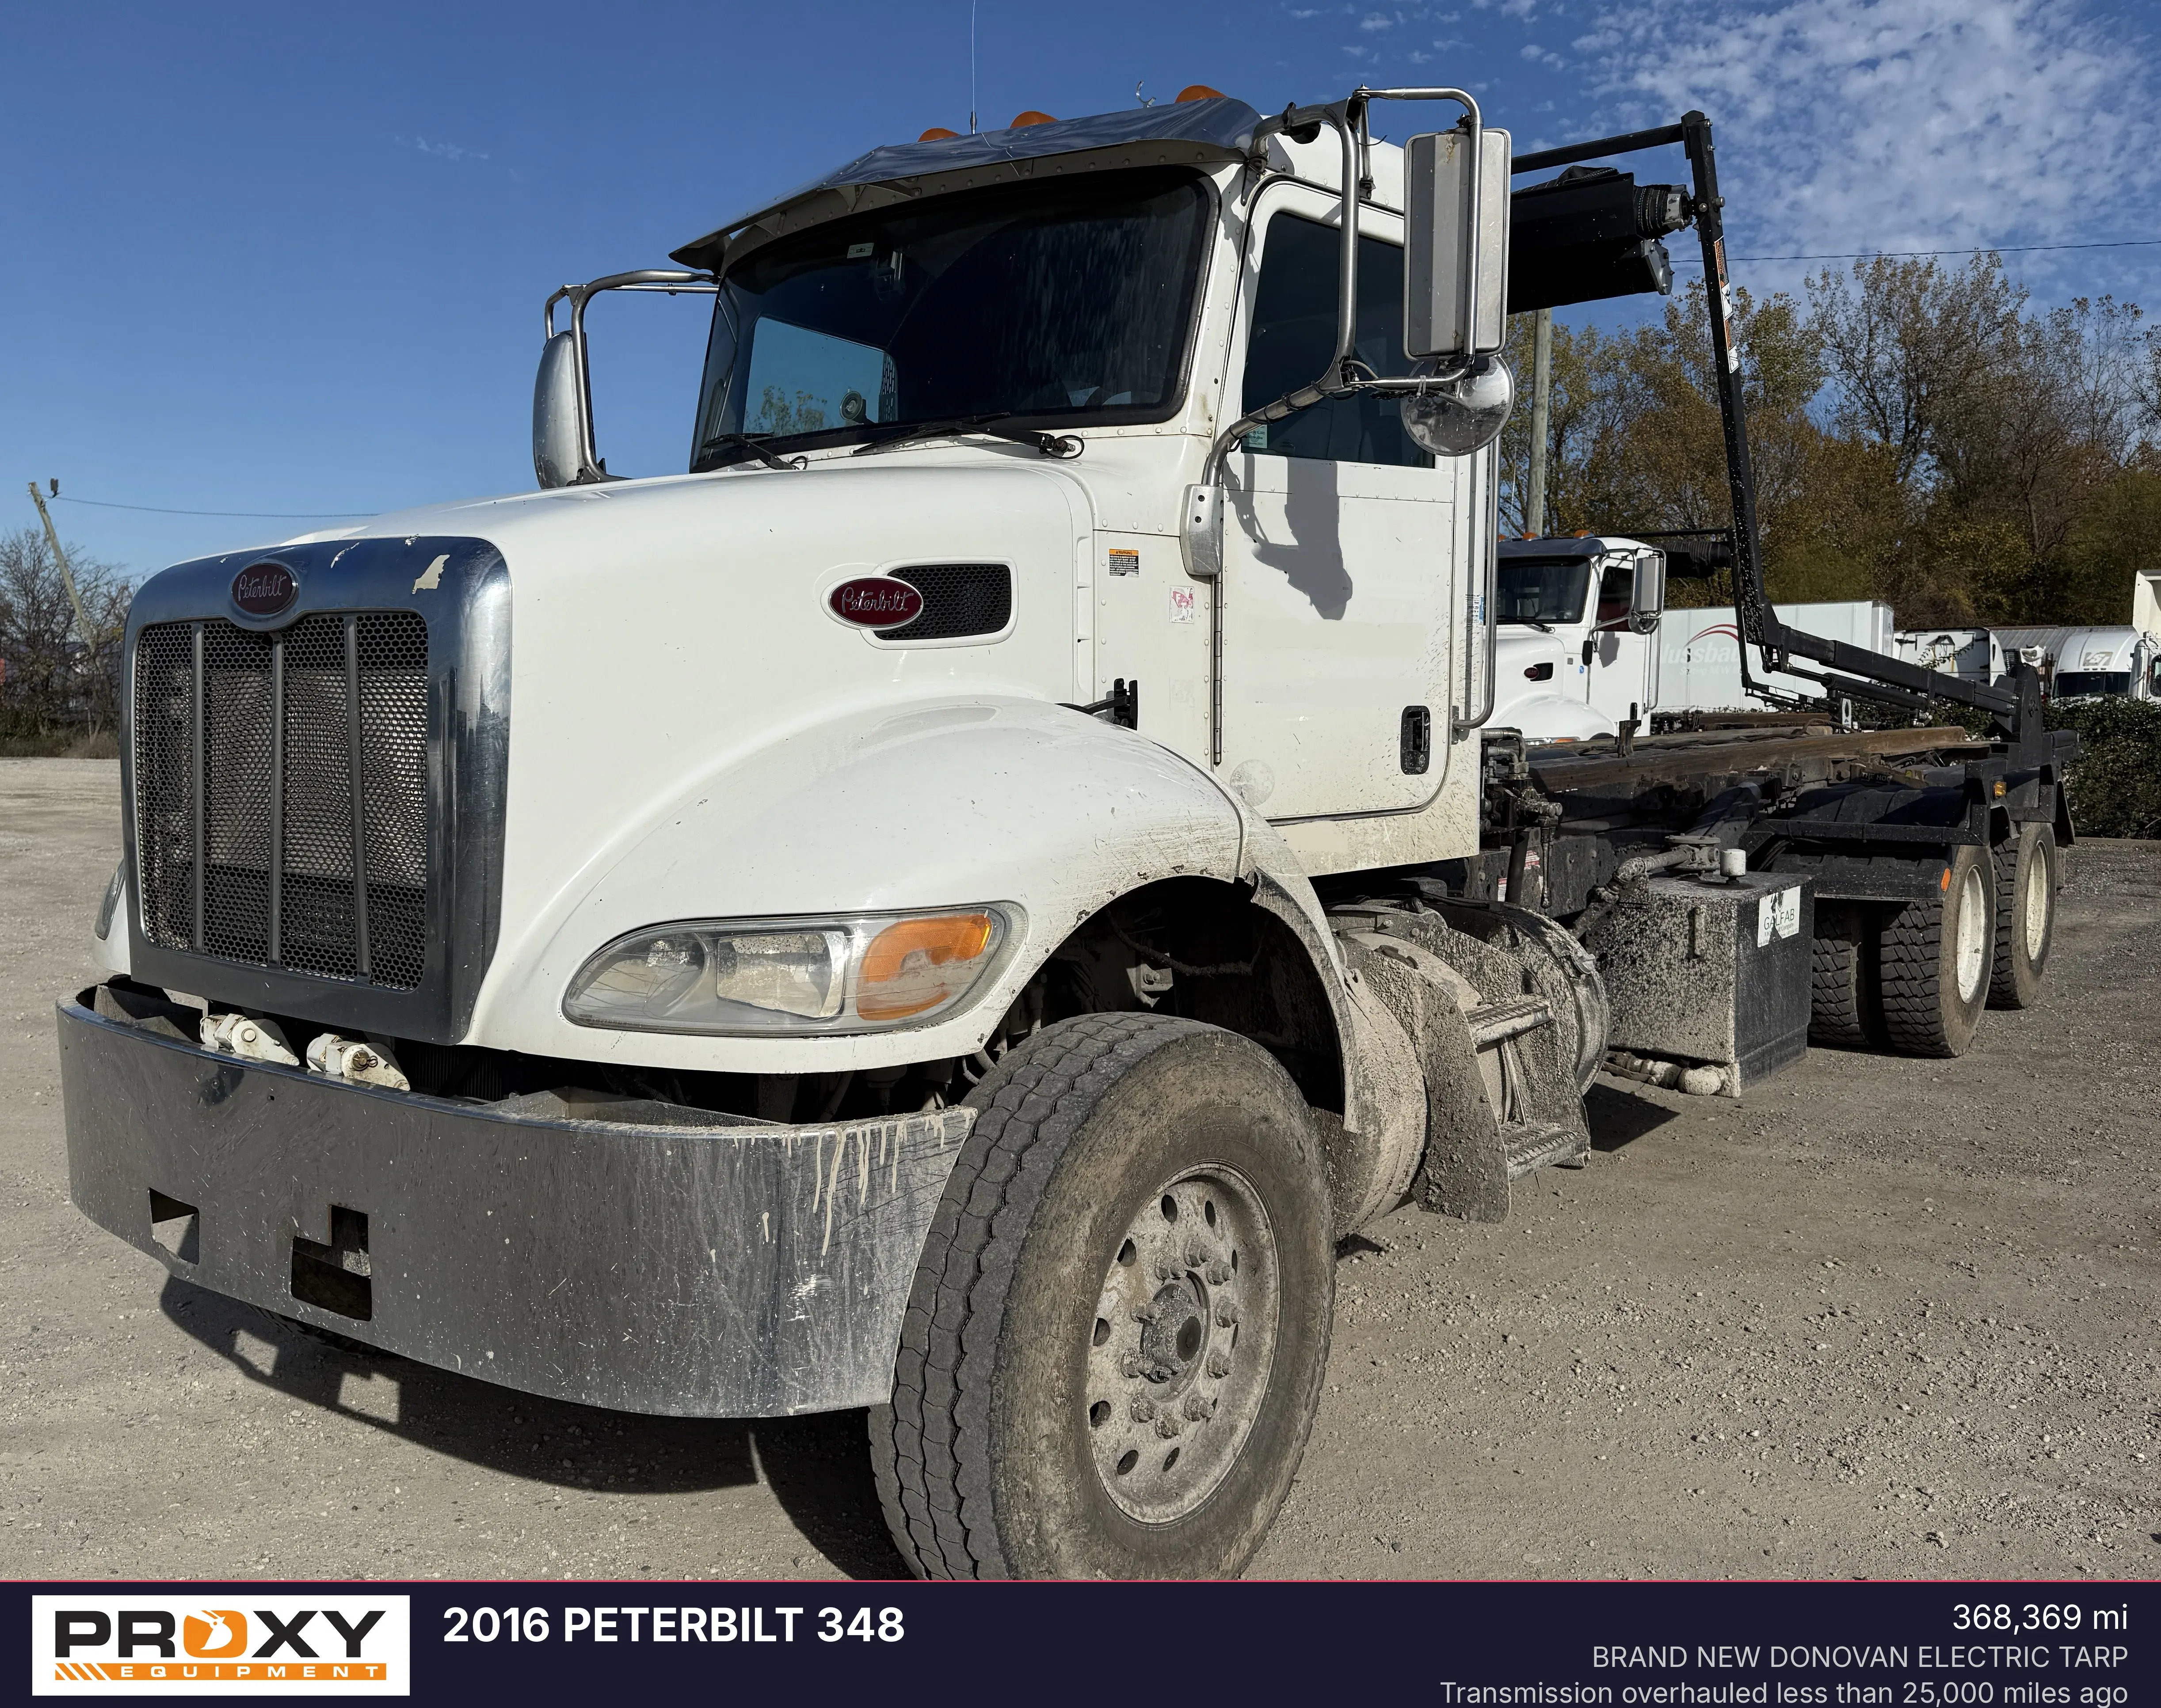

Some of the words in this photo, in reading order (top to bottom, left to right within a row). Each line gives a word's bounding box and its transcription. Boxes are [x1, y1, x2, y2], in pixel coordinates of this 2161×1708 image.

[238, 574, 286, 601] Peterbilt
[842, 586, 914, 613] Peterbilt
[1764, 908, 1795, 930] GALFAB
